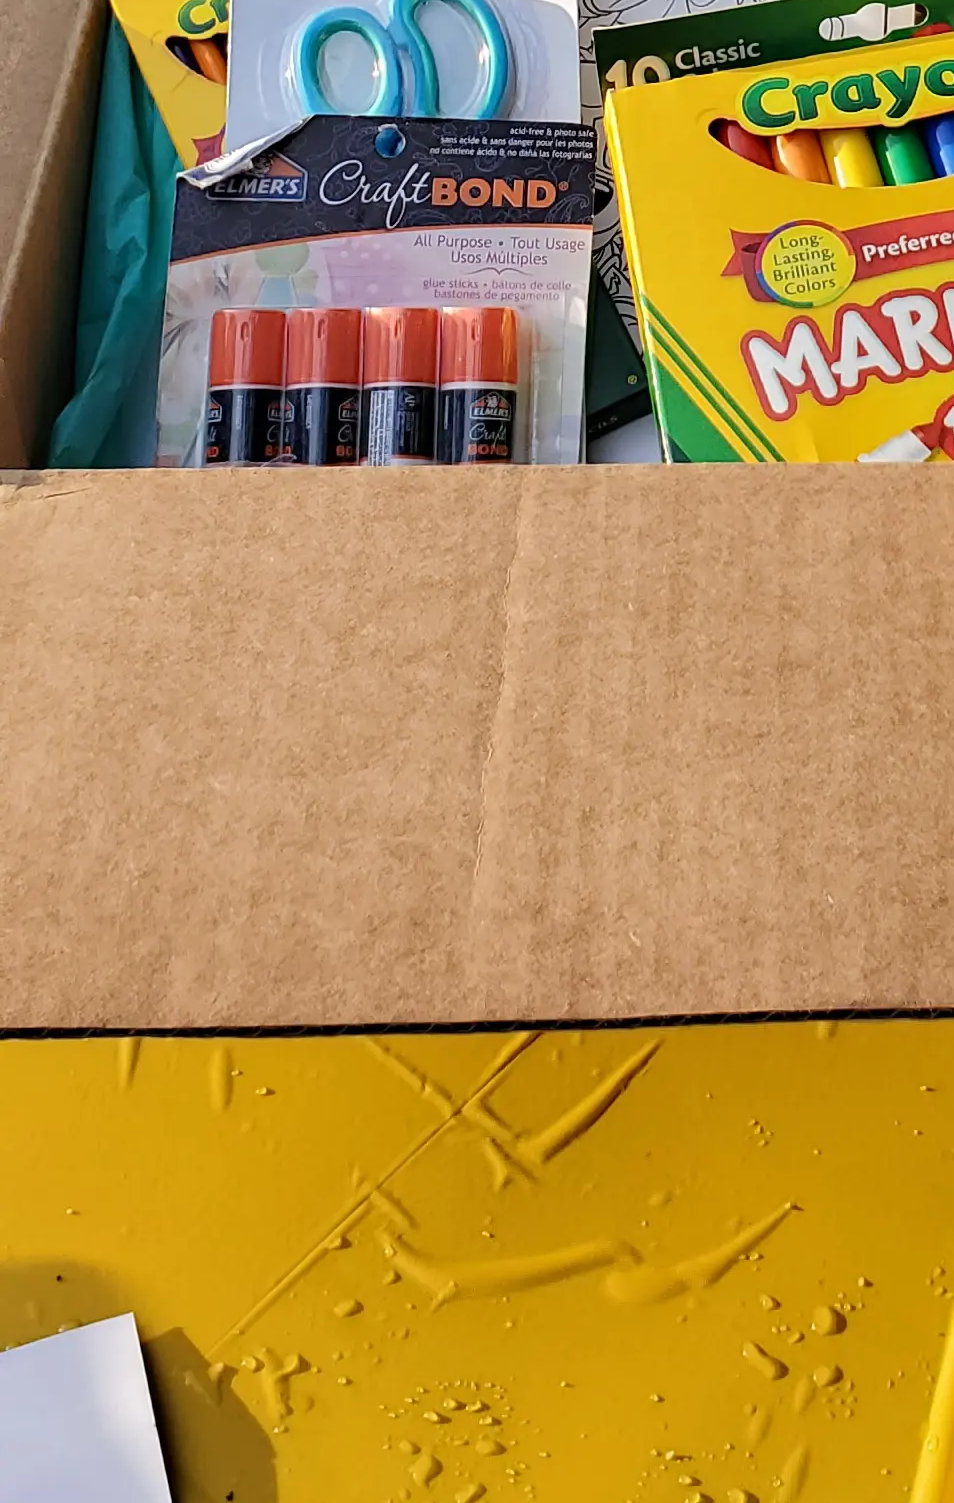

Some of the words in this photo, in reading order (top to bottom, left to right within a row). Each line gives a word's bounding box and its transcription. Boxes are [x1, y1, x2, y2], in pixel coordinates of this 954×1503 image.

[674, 38, 761, 70] Classic
[509, 127, 545, 136] acid-free
[553, 128, 577, 139] photo
[577, 128, 595, 138] safe
[429, 147, 441, 156] no
[441, 147, 475, 157] contiene
[507, 149, 518, 158] no
[539, 149, 550, 158] las
[440, 136, 457, 145] sans
[489, 138, 507, 146] sans
[507, 137, 535, 148] danger
[535, 139, 554, 149] pour
[554, 139, 567, 148] les
[567, 139, 594, 150] photos
[213, 177, 301, 196] ELMER'S
[413, 234, 432, 247] All
[437, 234, 493, 251] Purpose
[510, 236, 541, 250] Tout
[545, 237, 586, 253] Usage
[778, 234, 825, 253] Long-
[451, 250, 482, 265] Usos
[486, 250, 548, 267] Múltiples
[772, 247, 836, 267] Lasting,
[772, 261, 838, 283] Brilliant
[423, 278, 446, 289] glue
[449, 278, 479, 289] sticks
[529, 279, 543, 290] de
[546, 278, 572, 291] colle
[783, 275, 837, 296] Colors
[434, 288, 481, 300] bastones
[484, 289, 498, 300] de
[500, 290, 560, 303] pegamento
